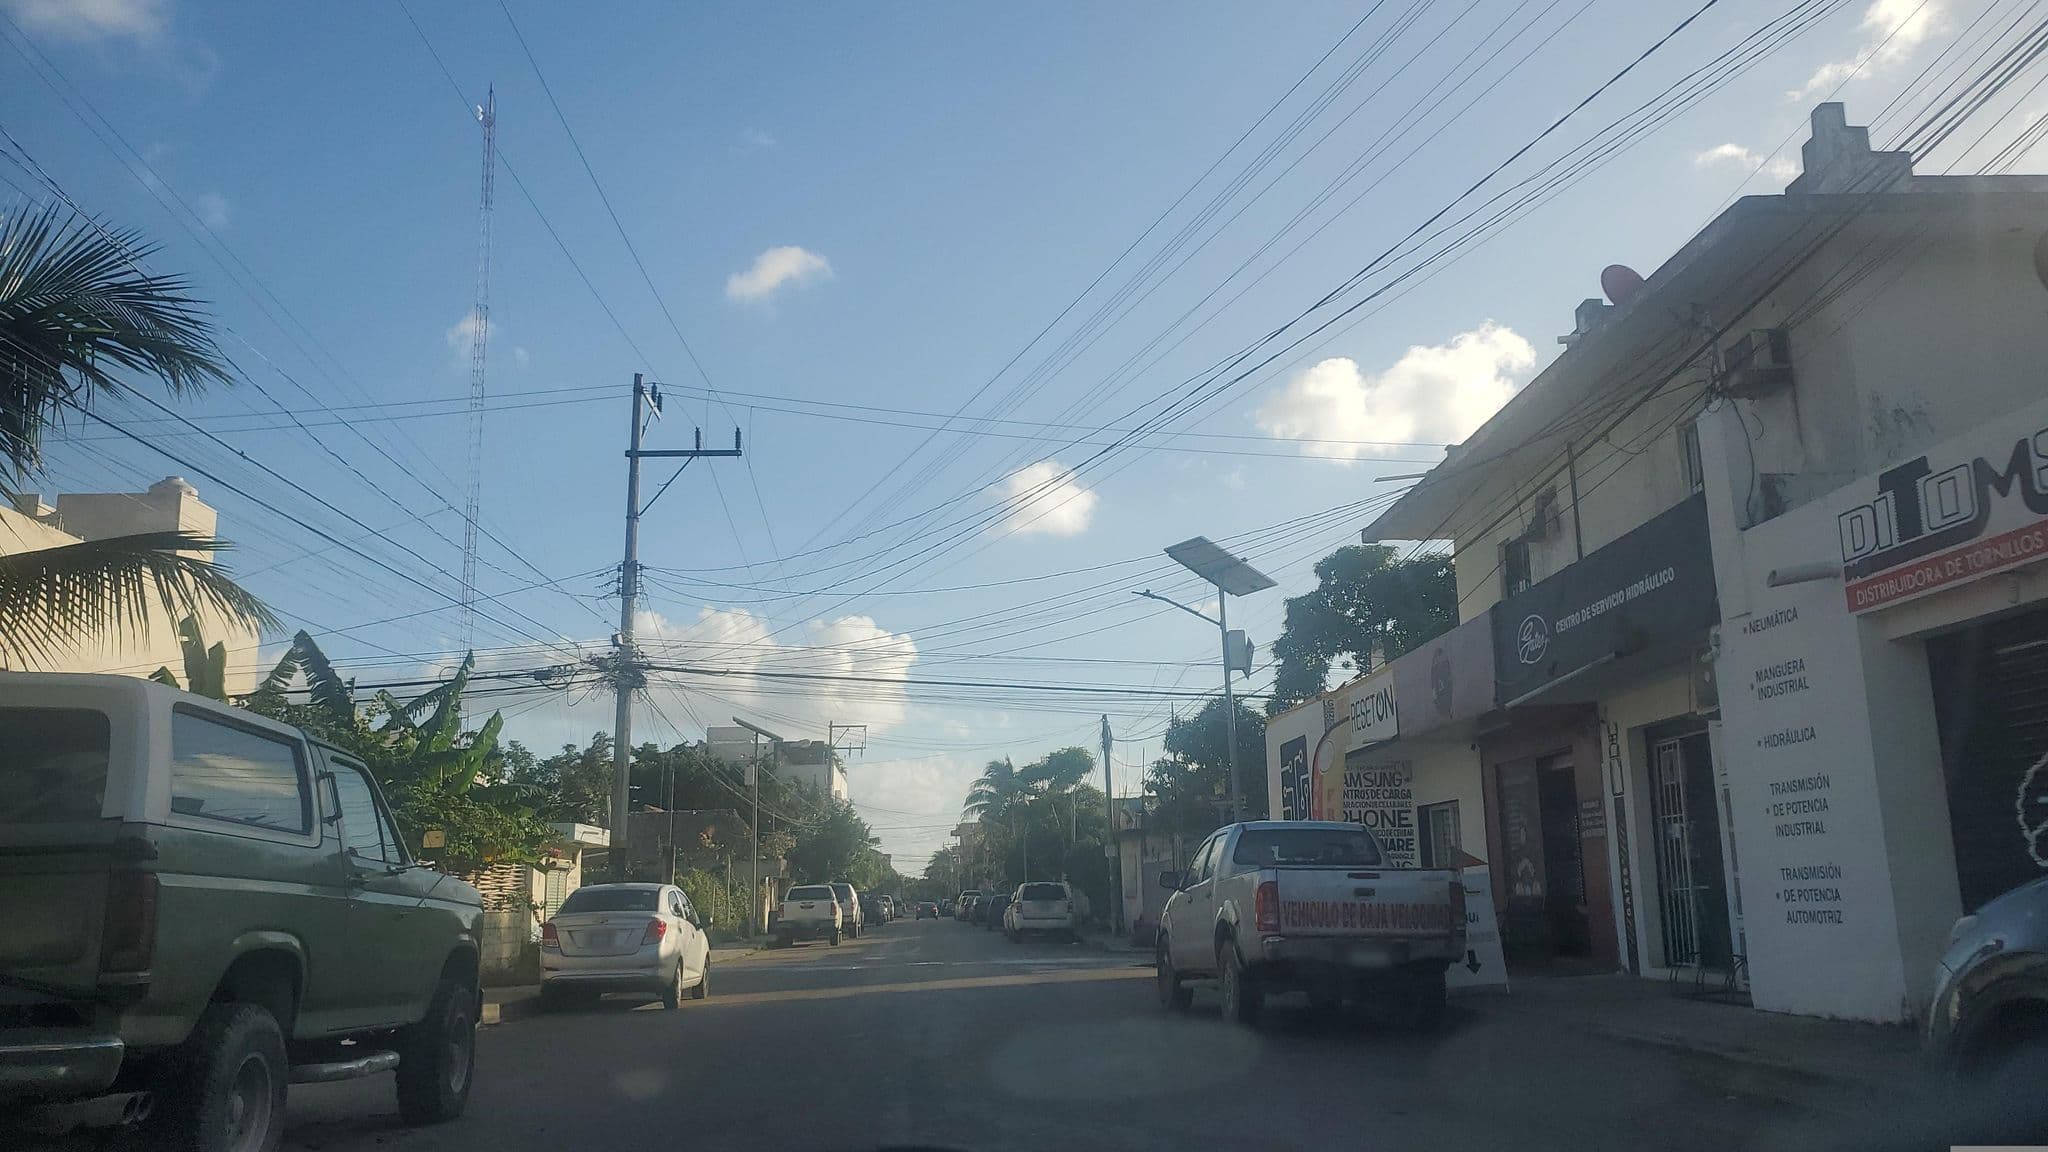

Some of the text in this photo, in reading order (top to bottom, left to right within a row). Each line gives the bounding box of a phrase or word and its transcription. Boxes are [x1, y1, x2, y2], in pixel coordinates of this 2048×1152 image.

[1855, 567, 1944, 606] DISTRIBUIDORA
[1945, 558, 1965, 577] DE
[1555, 566, 1676, 634] CENTRO DE SERVICIO HIDRÁULICO
[1748, 606, 1799, 636] NEUMÁTICA
[1755, 657, 1806, 684] MANGUERA
[1757, 676, 1810, 701] INDUSTRIAL
[1350, 683, 1394, 734] RESETON
[1763, 726, 1817, 748] HIDRÁULICA
[1769, 773, 1831, 796] TRANSMISIÓN
[1772, 797, 1829, 817] DE POTENCIA
[1774, 819, 1827, 838] INDUSTRIAL
[1779, 862, 1842, 880] TRANSMISIÓN
[1783, 888, 1842, 903] DE POTENCIA
[1786, 910, 1843, 924] AUTOMOTRIZ
